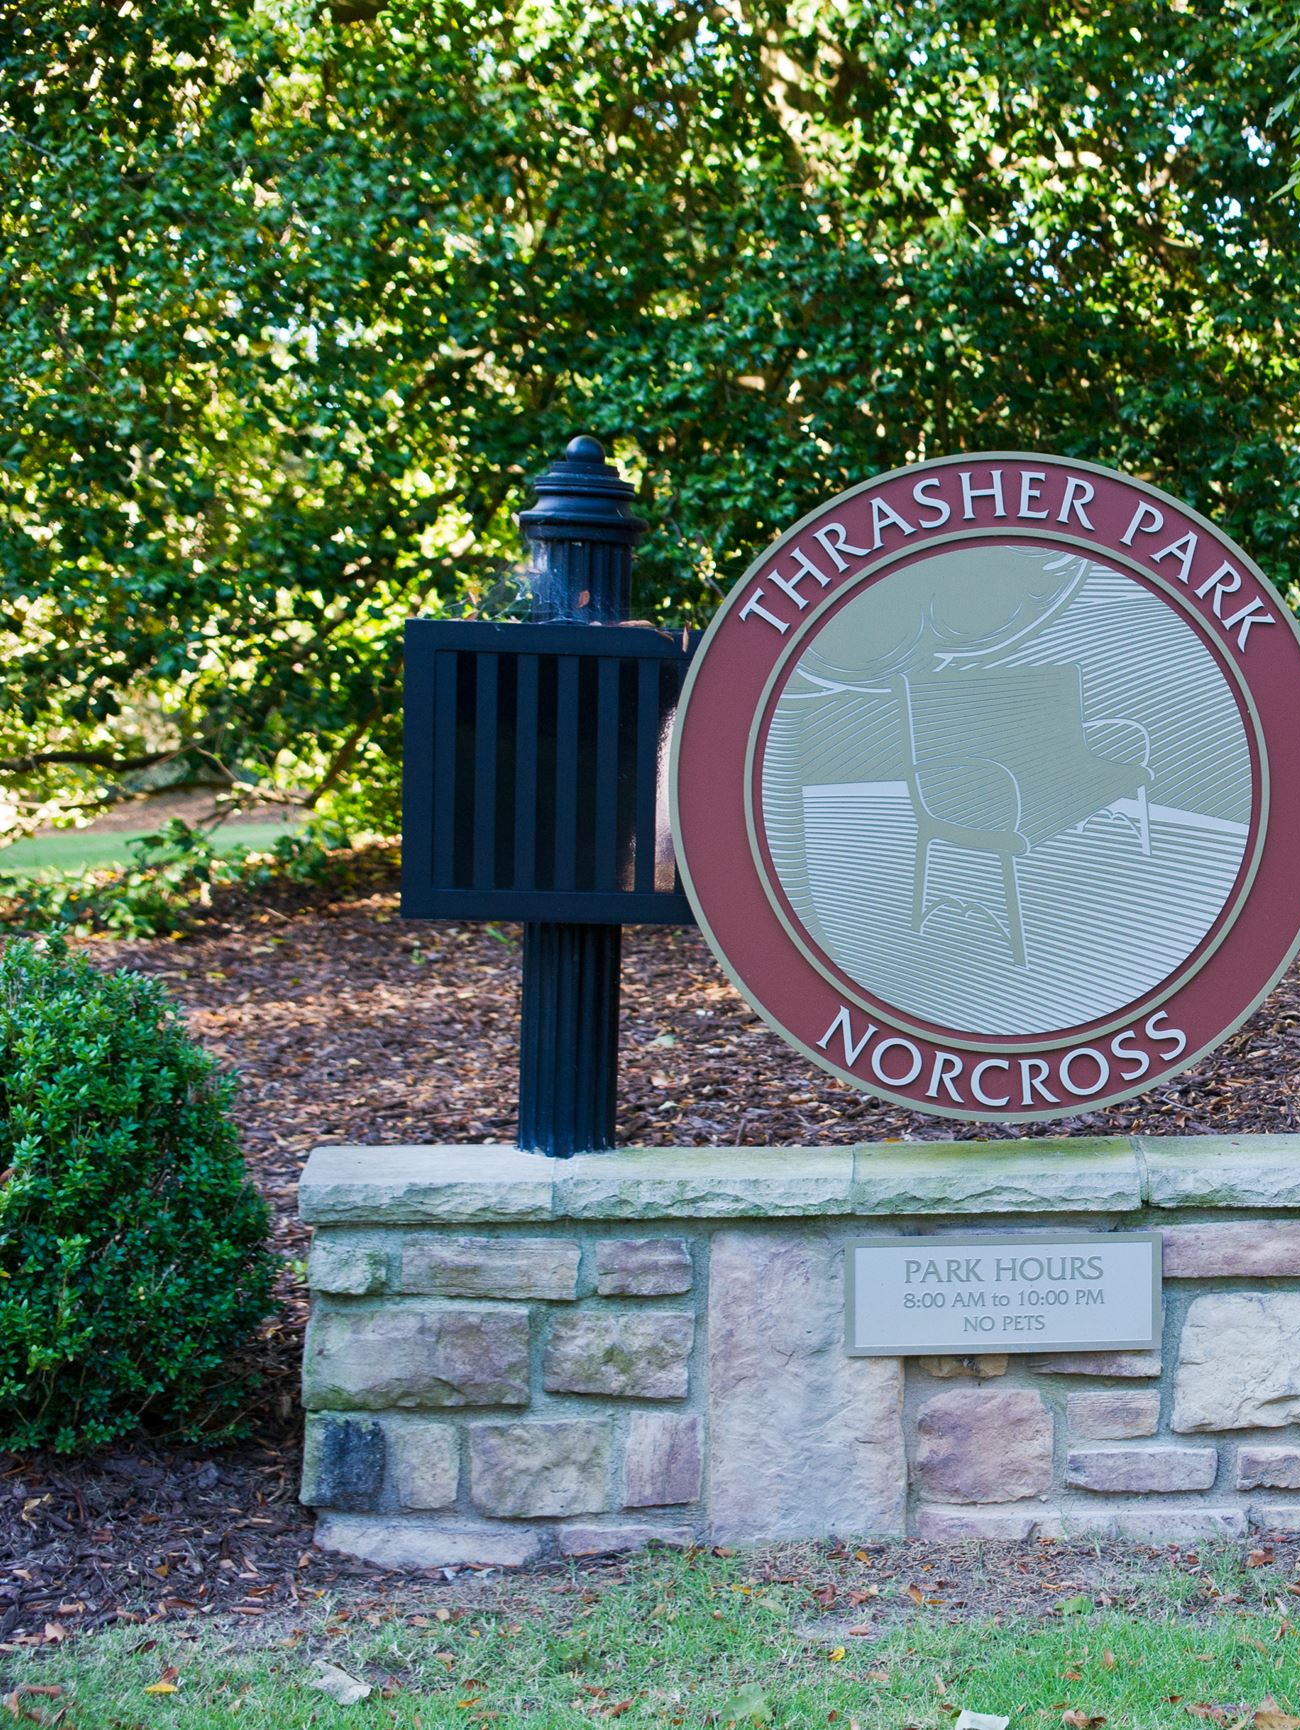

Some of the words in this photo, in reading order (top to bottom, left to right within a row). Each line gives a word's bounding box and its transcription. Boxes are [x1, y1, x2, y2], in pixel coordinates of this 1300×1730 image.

[739, 470, 1096, 635] THRASHER
[1119, 500, 1276, 653] PARK
[816, 1005, 1187, 1107] NORCROSS
[904, 1257, 984, 1283] PARK
[994, 1256, 1104, 1282] HOURS
[903, 1292, 945, 1309] 8:00
[951, 1291, 986, 1308] AM
[991, 1291, 1010, 1307] to
[1018, 1289, 1069, 1306] 10:00
[1075, 1289, 1105, 1305] PM
[964, 1316, 995, 1332] NO
[1002, 1315, 1045, 1331] PETS
